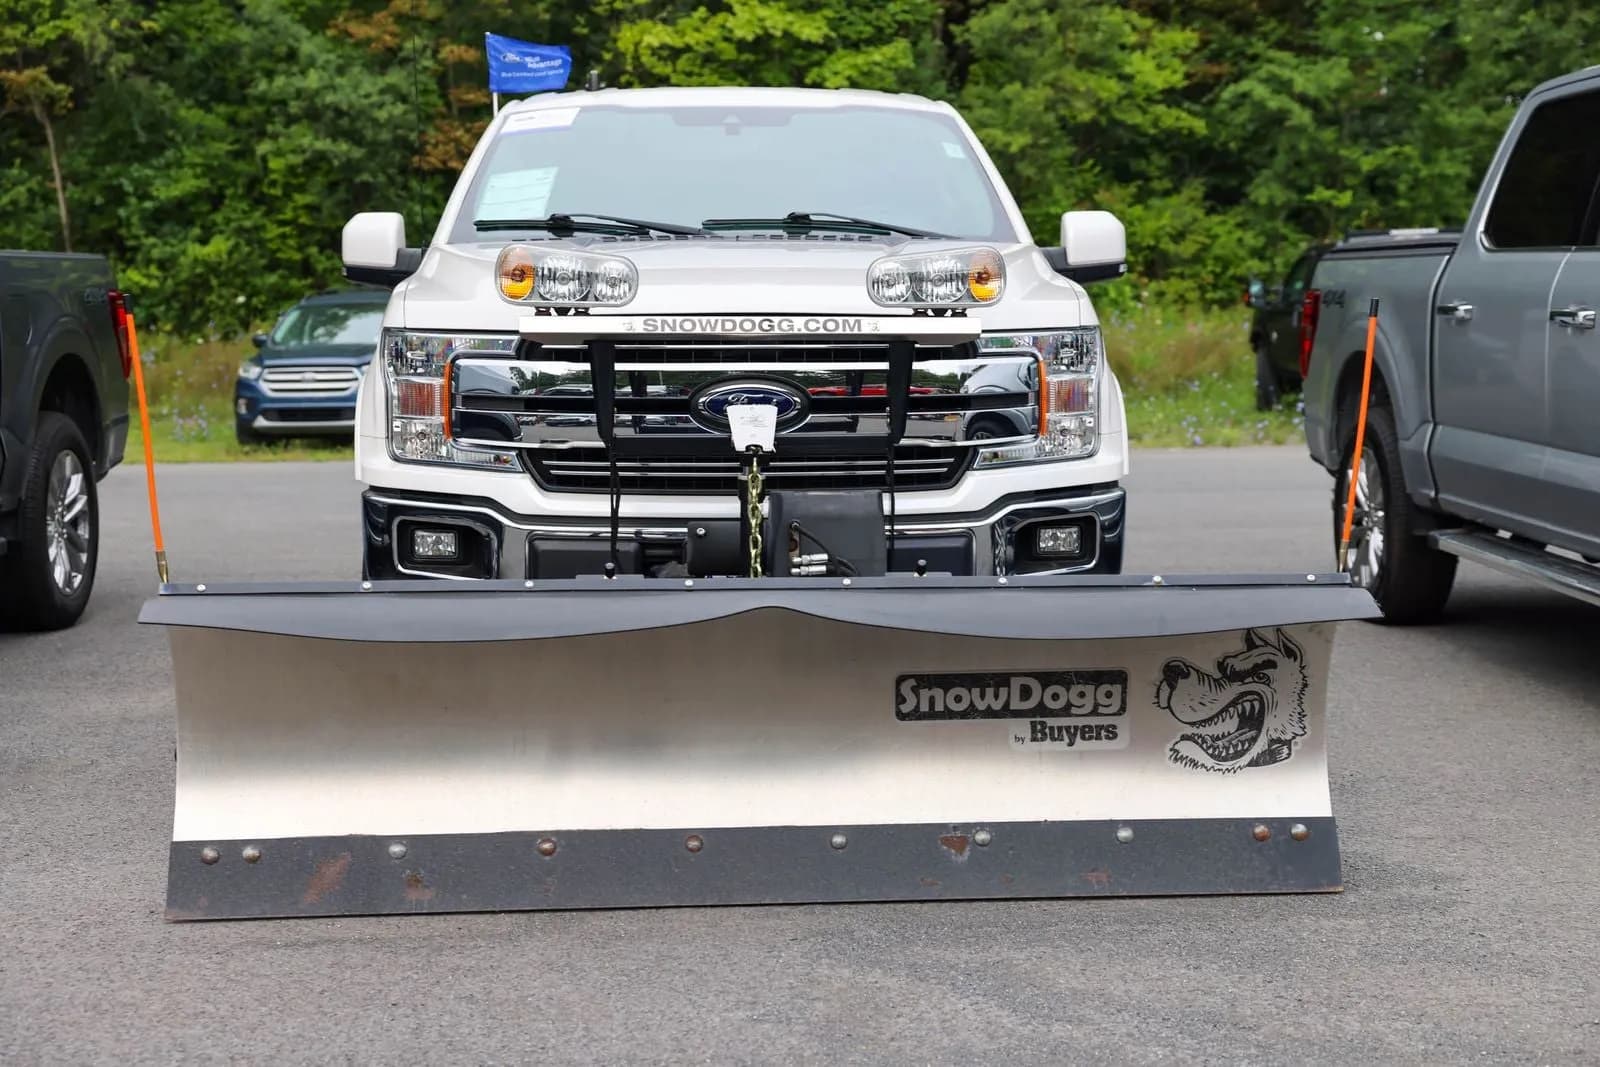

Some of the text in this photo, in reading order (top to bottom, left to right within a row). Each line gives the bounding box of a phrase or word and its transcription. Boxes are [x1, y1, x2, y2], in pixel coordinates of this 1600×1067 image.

[642, 318, 863, 333] SNOWDOGG.COM
[899, 676, 1122, 715] SnowDogg
[1014, 720, 1119, 747] by Buyers
